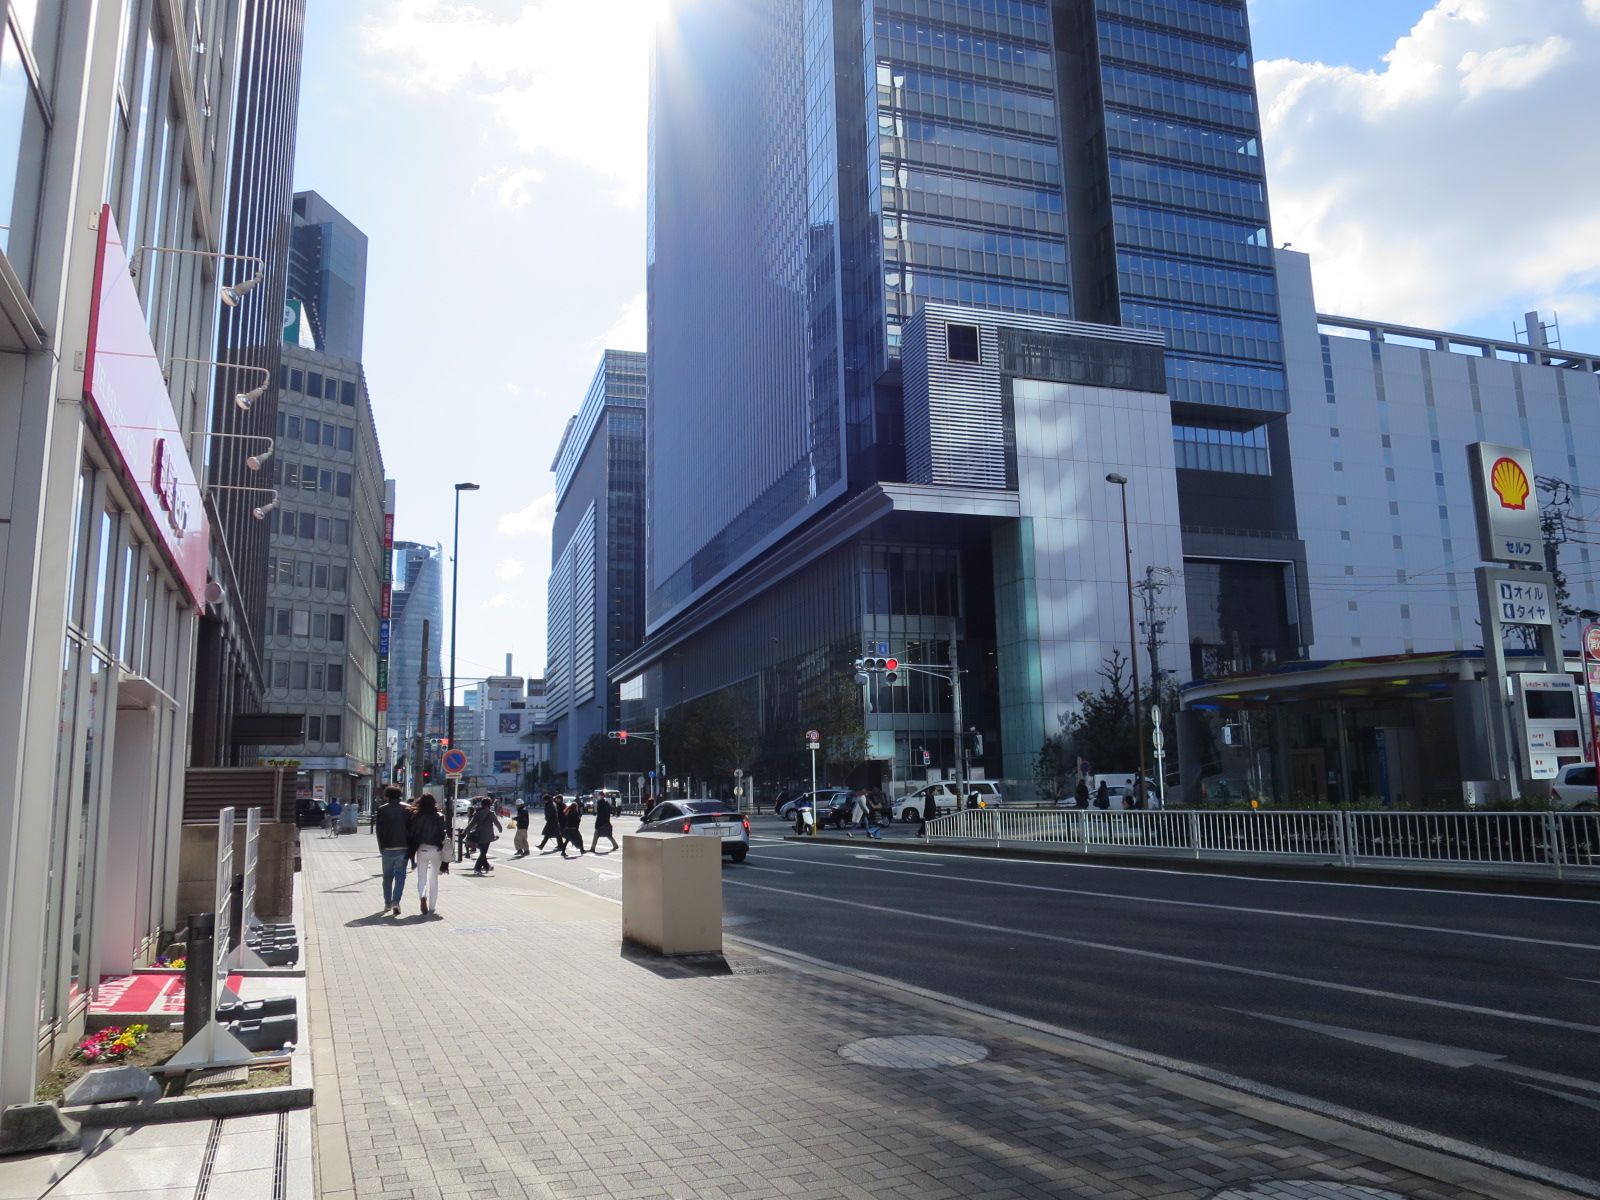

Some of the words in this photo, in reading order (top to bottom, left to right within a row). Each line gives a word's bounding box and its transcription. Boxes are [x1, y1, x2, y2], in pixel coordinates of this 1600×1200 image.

[1505, 540, 1532, 555] セルフ
[1513, 586, 1544, 601] オイル
[1516, 604, 1546, 620] タイヤ
